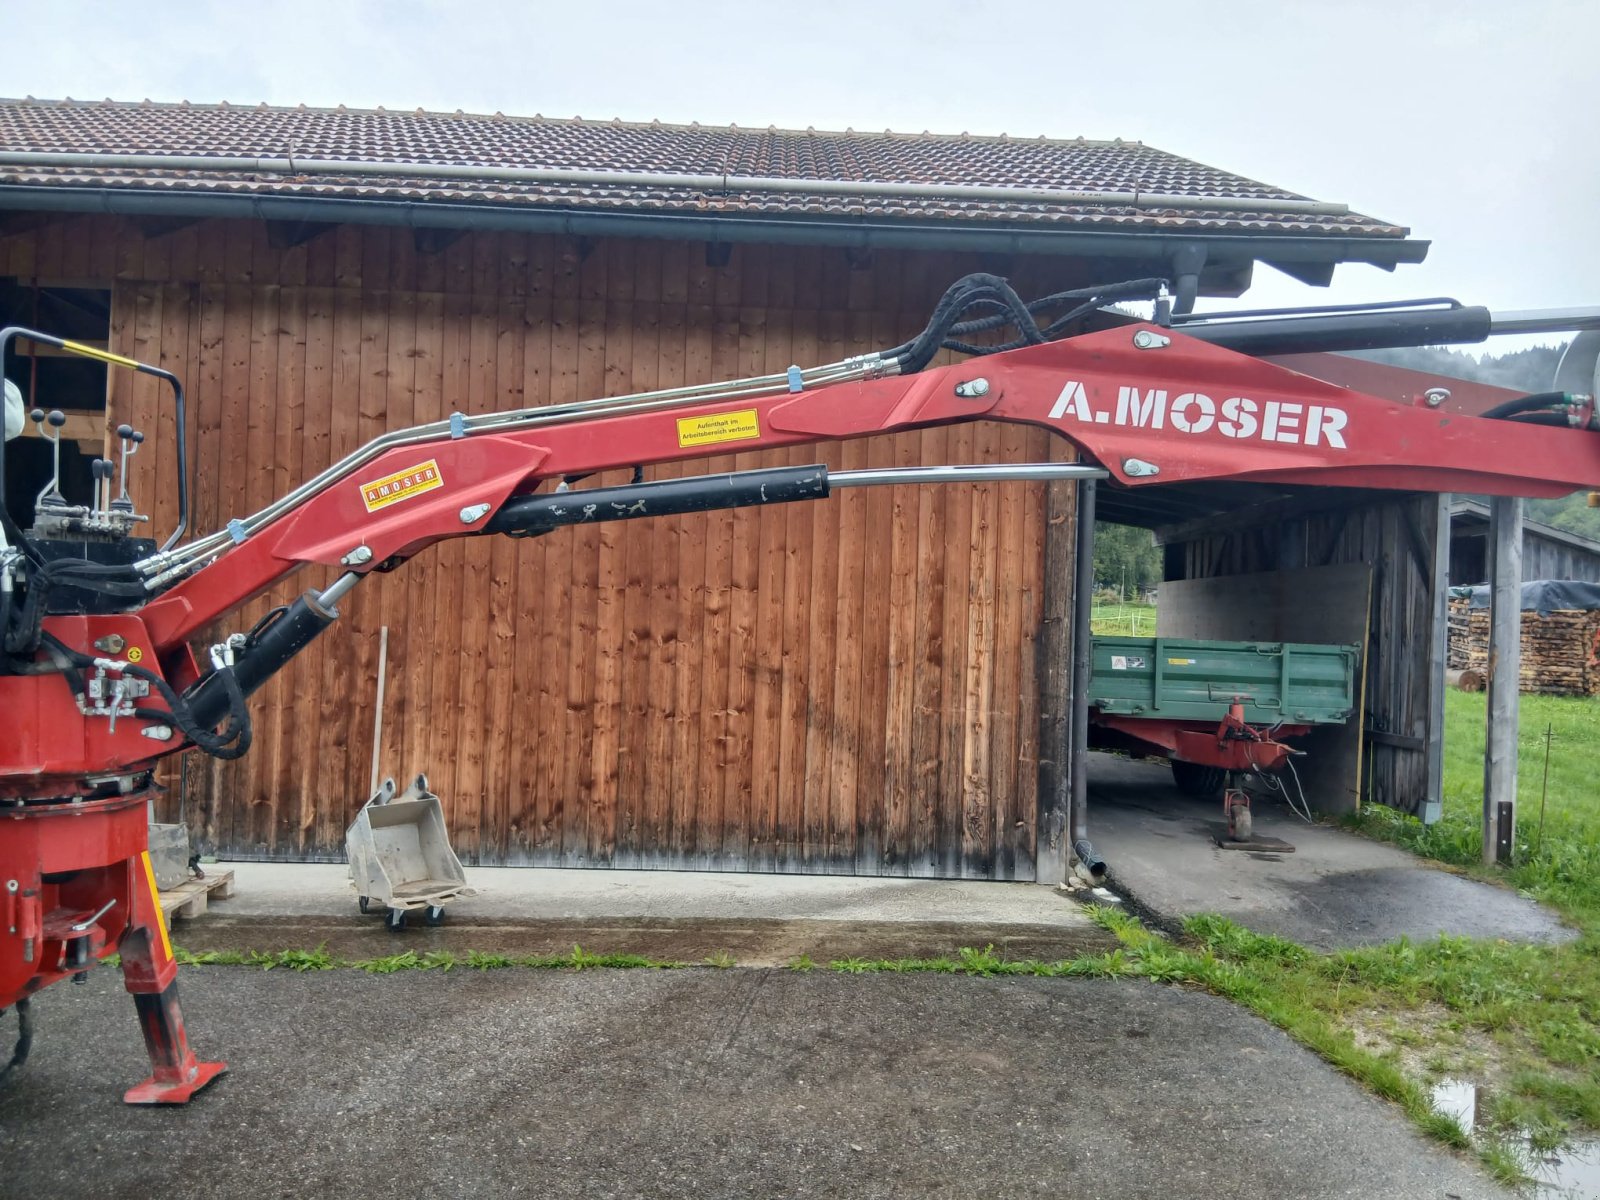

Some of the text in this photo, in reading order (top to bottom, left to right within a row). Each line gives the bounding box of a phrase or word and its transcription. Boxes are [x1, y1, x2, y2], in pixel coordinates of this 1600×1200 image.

[1047, 380, 1348, 449] A.MOSER
[682, 424, 756, 439] Arbeitsbereich verboten
[697, 420, 728, 429] Aufenthalt
